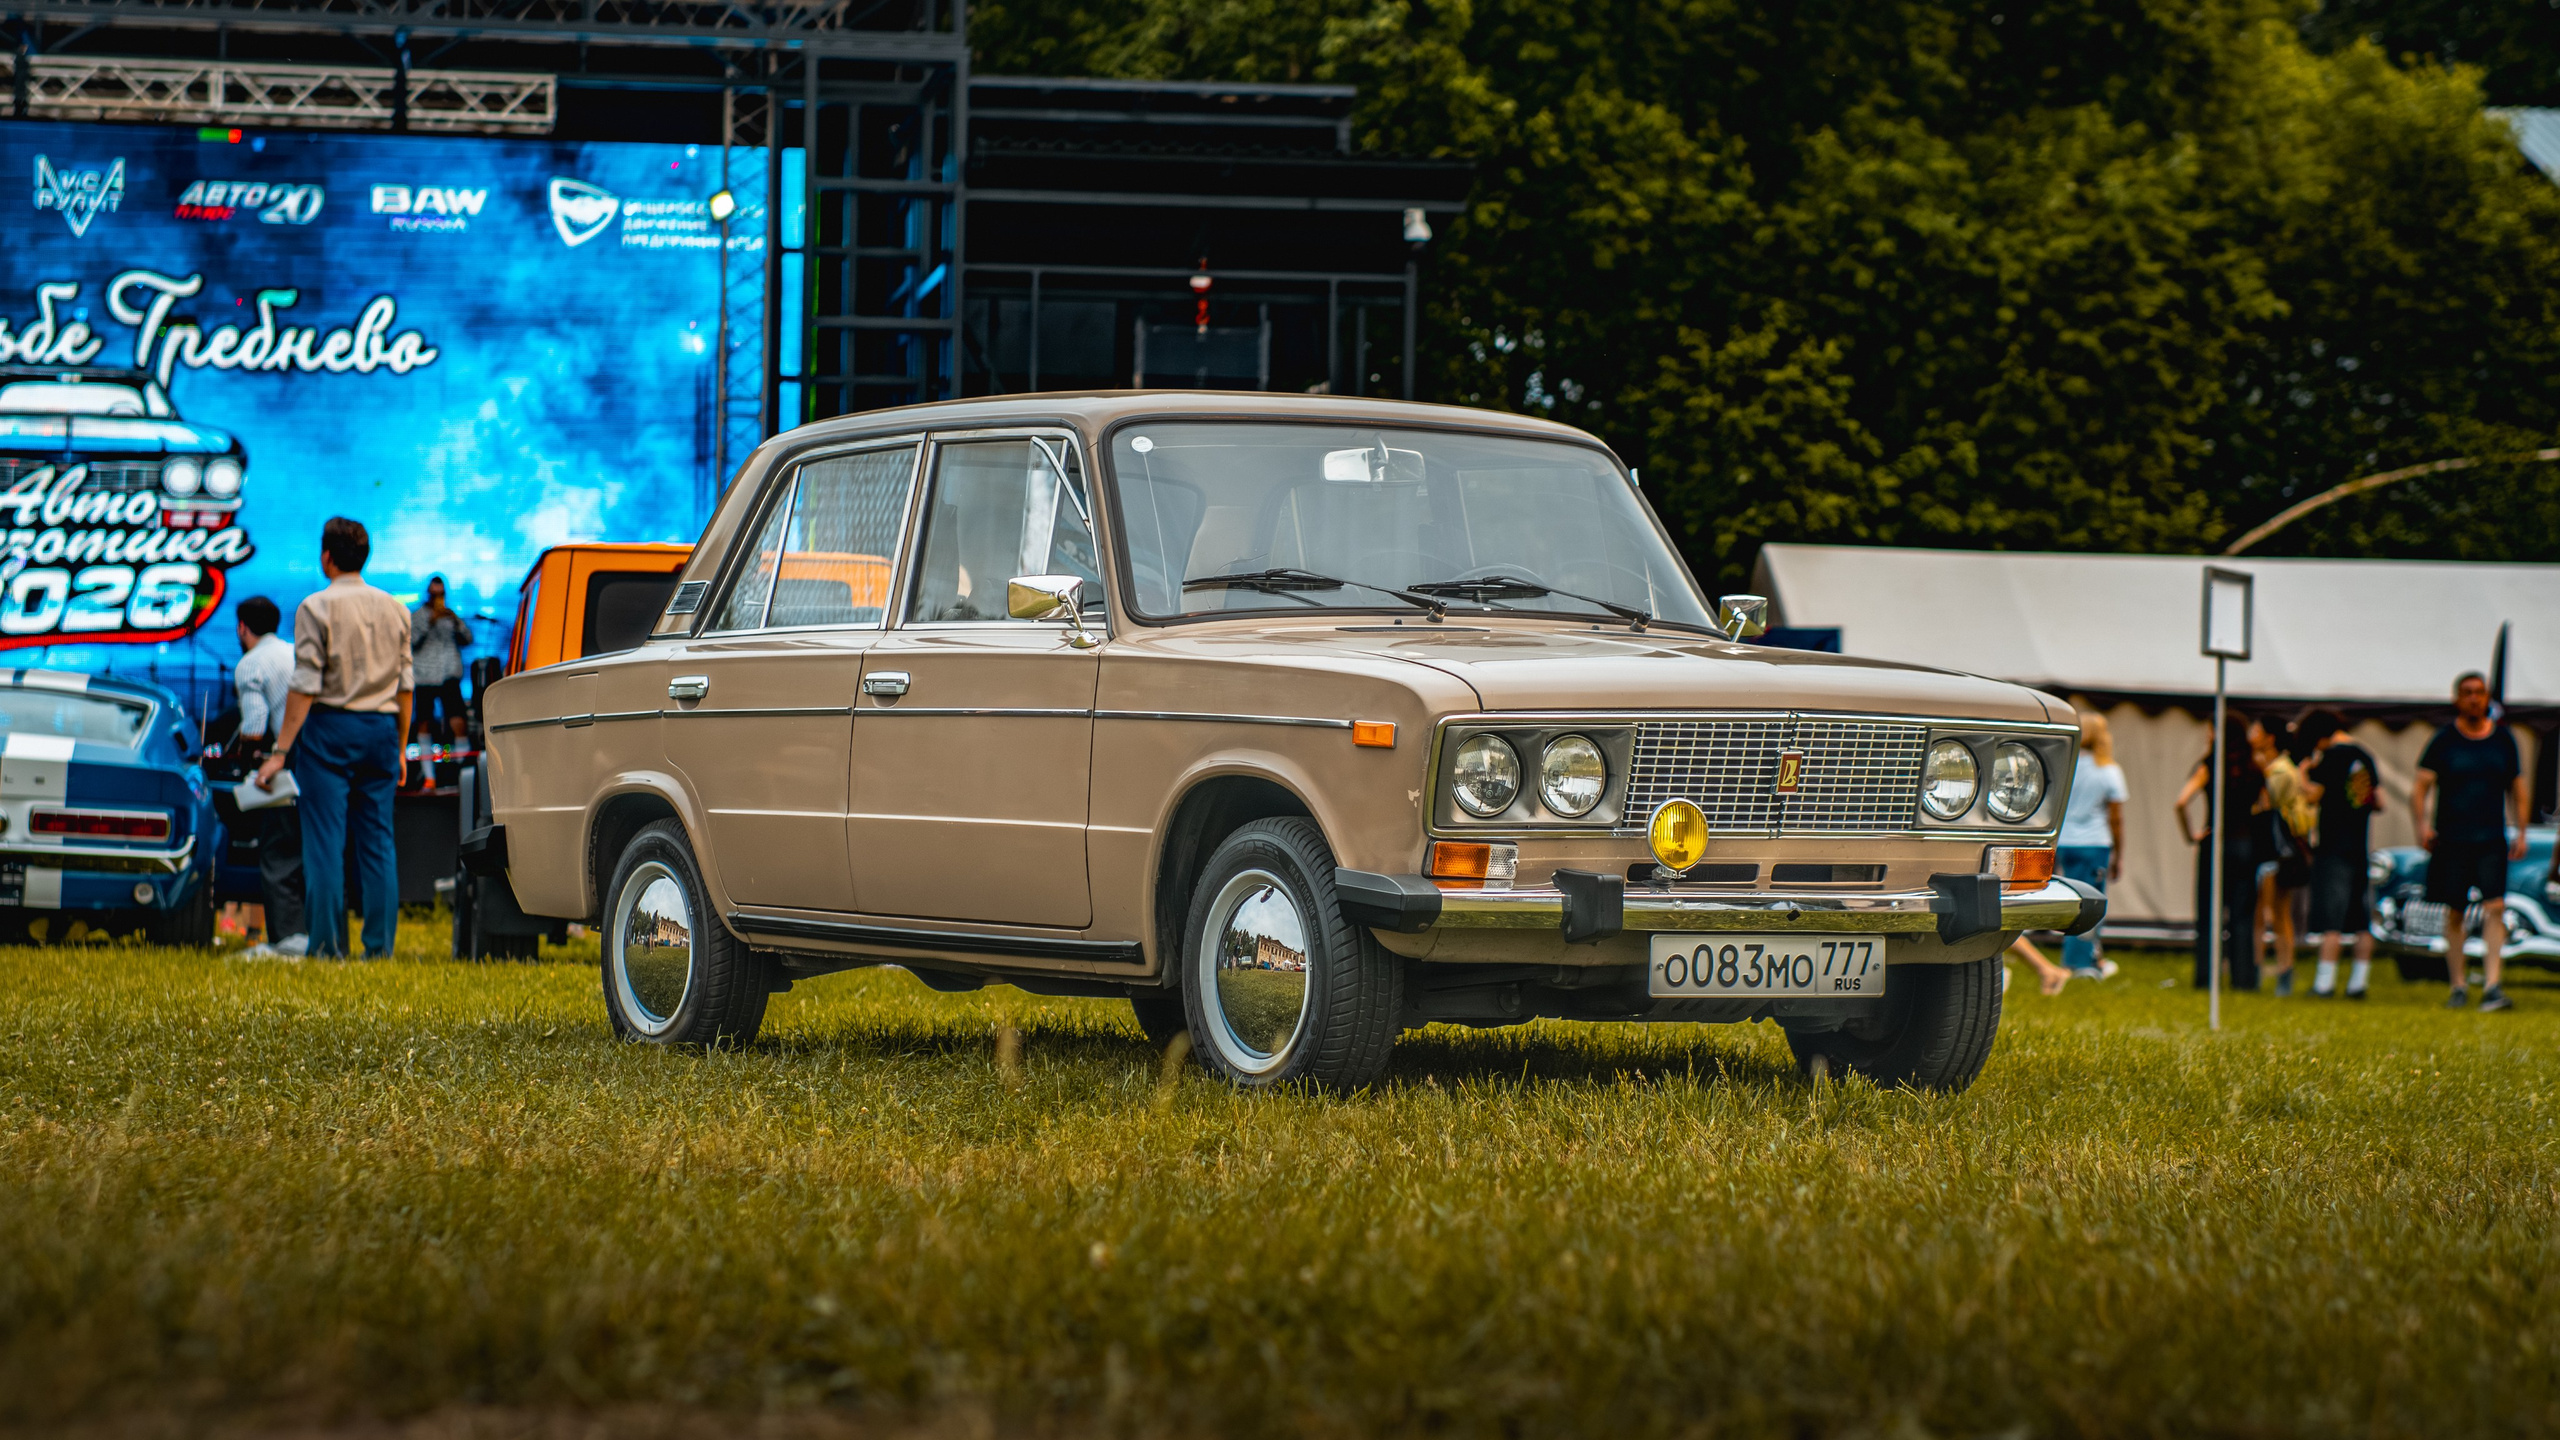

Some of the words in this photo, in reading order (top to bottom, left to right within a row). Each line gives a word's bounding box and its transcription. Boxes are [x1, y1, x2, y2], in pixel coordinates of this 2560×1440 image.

[178, 180, 270, 208] АВТО
[257, 183, 325, 225] 20
[371, 184, 488, 216] BAW
[106, 270, 439, 390] Гребнево
[0, 463, 158, 527] Авто
[0, 562, 203, 636] 026
[1288, 864, 1316, 917] MAXIMUM
[1821, 942, 1873, 977] 777
[1834, 978, 1862, 991] RUS
